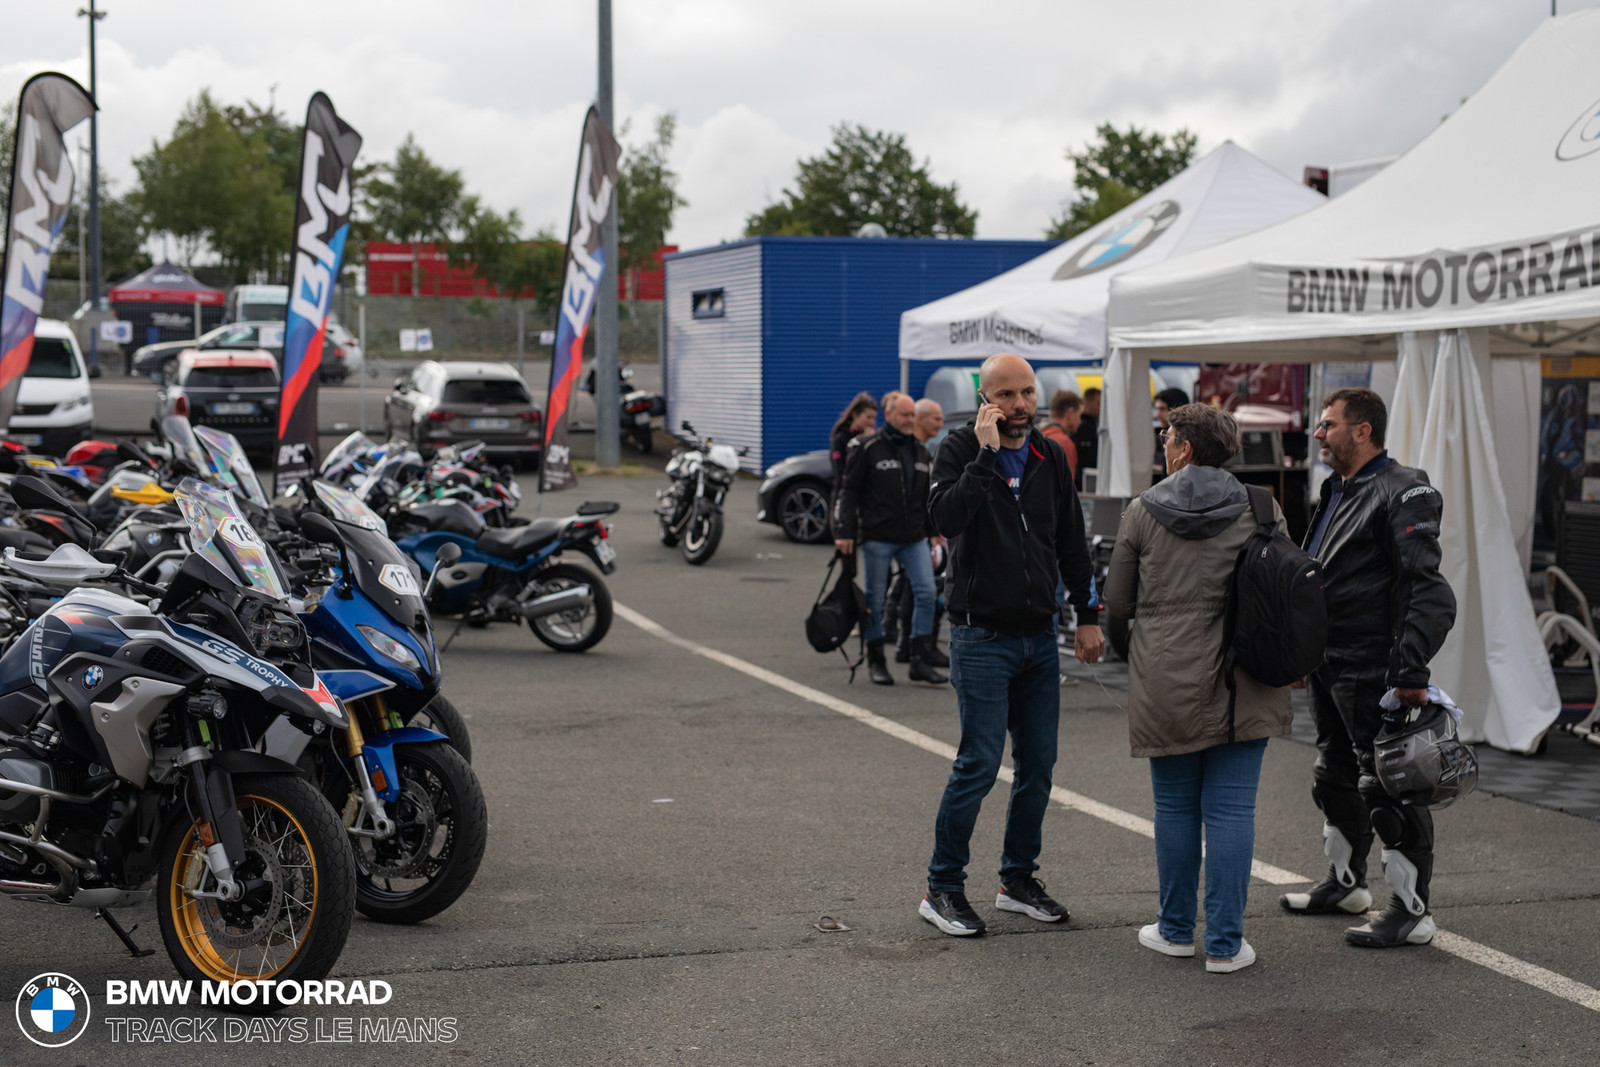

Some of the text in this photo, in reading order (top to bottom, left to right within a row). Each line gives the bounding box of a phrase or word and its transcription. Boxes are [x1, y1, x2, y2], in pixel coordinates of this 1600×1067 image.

[290, 128, 351, 331] BMC
[1287, 267, 1370, 313] BMW
[949, 319, 981, 344] BMW
[202, 639, 289, 688] GS TROPHY
